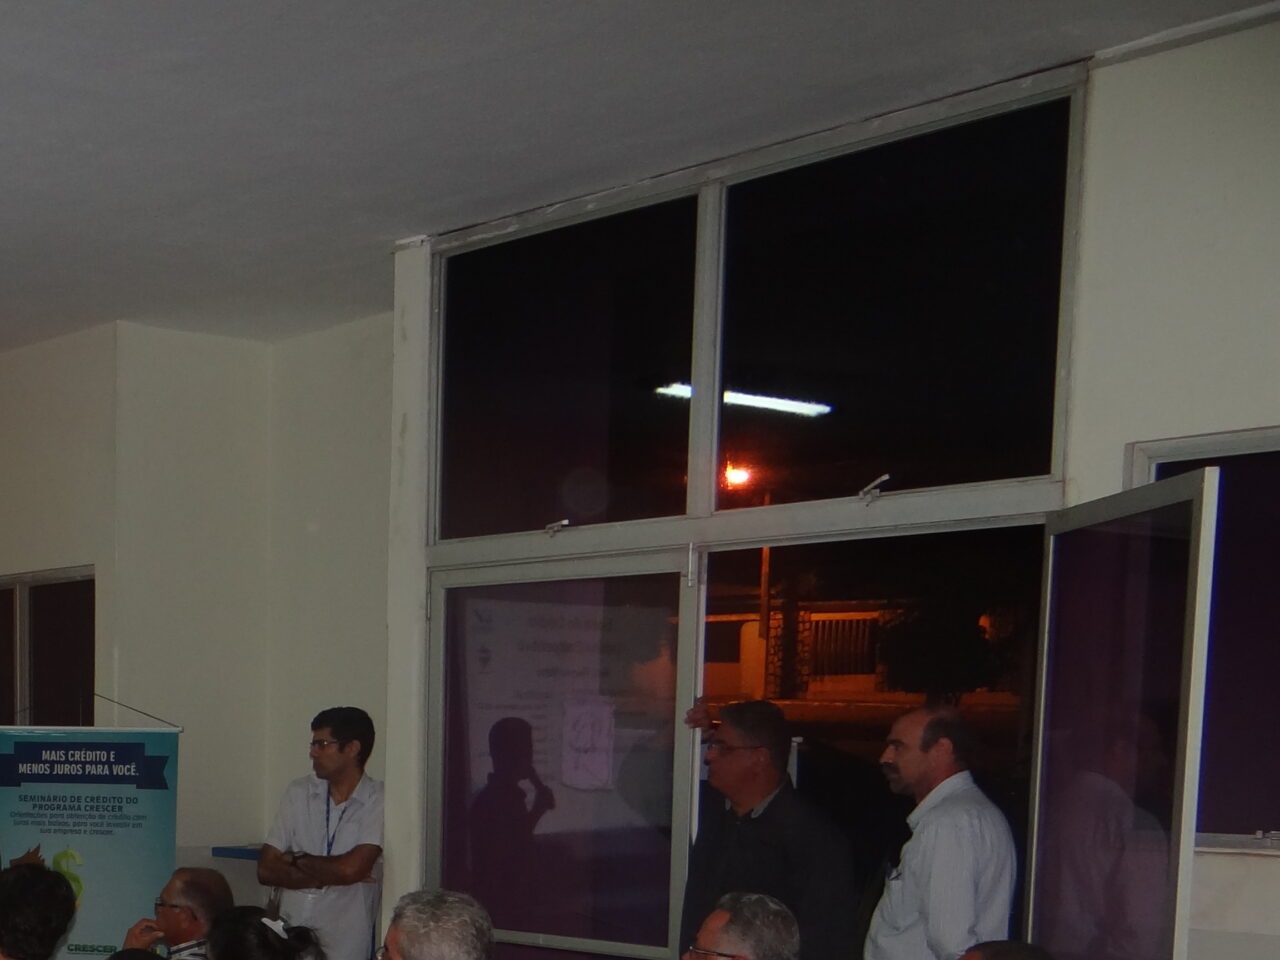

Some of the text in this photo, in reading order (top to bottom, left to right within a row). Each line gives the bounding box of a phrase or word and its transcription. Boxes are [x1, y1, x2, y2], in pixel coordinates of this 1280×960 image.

[42, 748, 116, 762] MAIS CRÉDITO E
[18, 762, 139, 776] MENOS JUROS PARA VOCÊ.
[70, 795, 82, 803] DE
[126, 796, 139, 804] DO
[32, 803, 124, 813] PROGRAMA CRESCER
[67, 943, 117, 953] CRESCER
